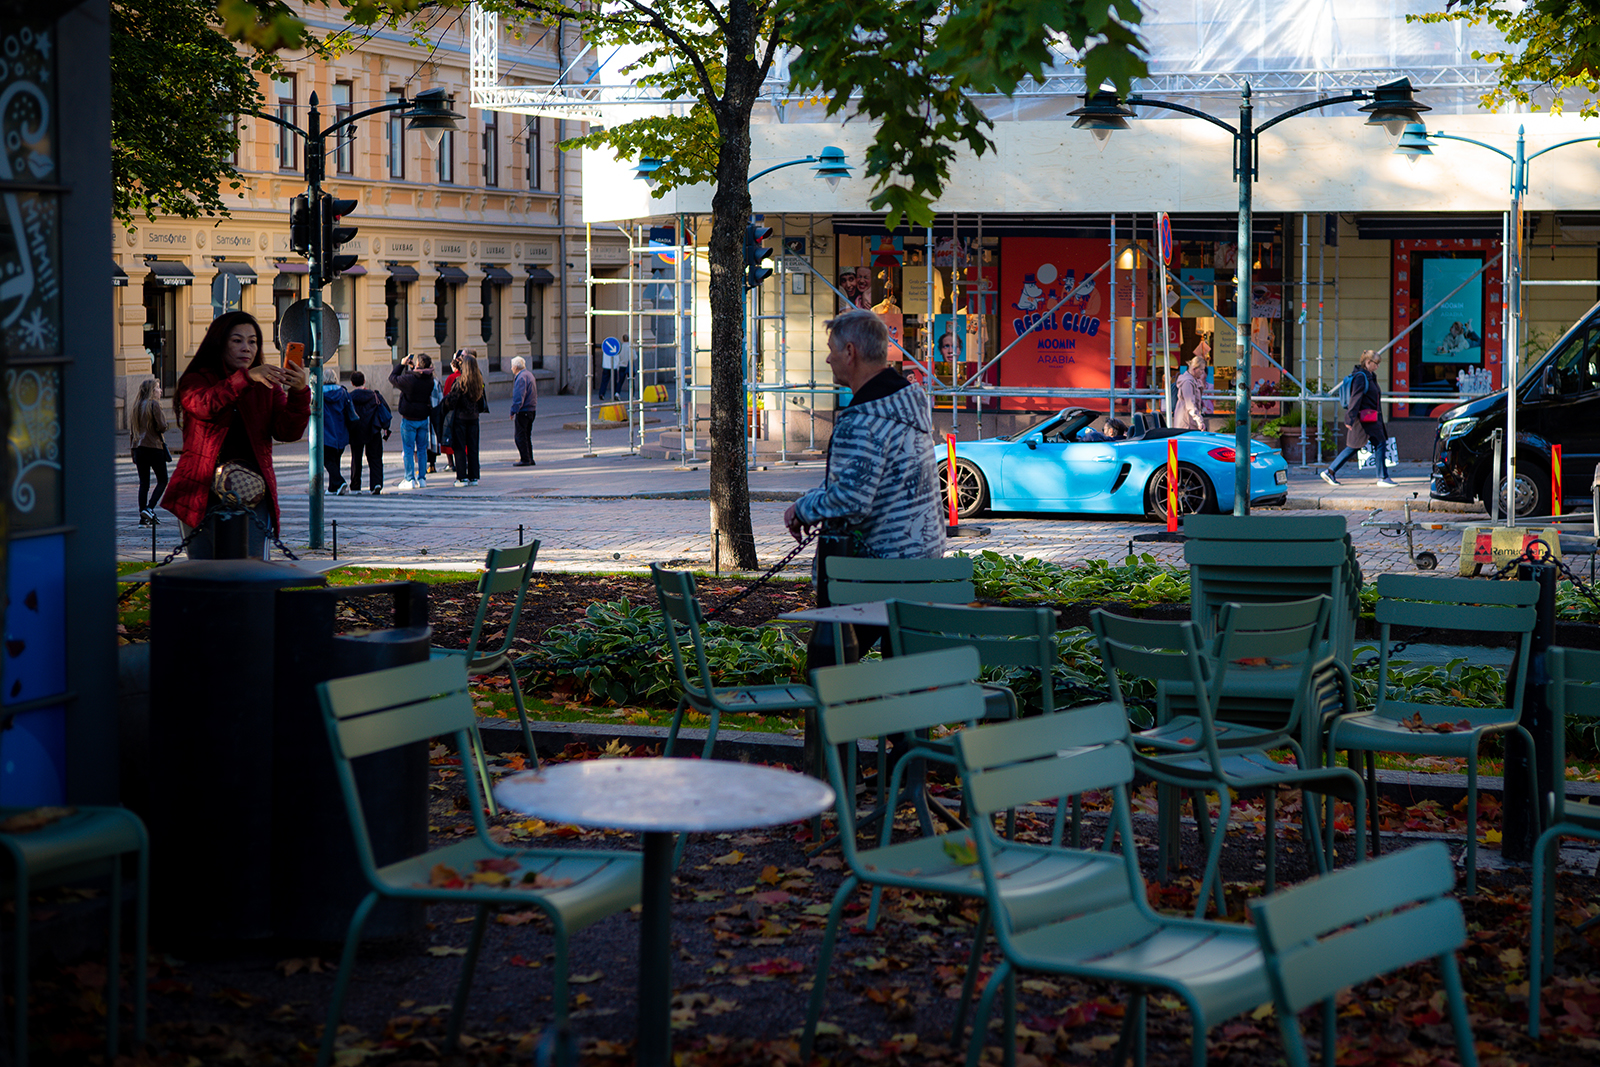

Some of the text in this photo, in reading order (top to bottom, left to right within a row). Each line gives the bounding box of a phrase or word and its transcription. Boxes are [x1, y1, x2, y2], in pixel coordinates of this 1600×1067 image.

[148, 232, 187, 244] Samsonite
[216, 235, 252, 246] Samsonite
[391, 243, 414, 252] LUXBAG
[440, 245, 461, 253] LUXBAG
[486, 246, 506, 254] LUXBAG
[529, 248, 548, 256] LUXBAG
[1013, 311, 1100, 337] REBEL CLUB
[1037, 338, 1076, 349] MOOMIN
[1037, 354, 1076, 364] ARABIA
